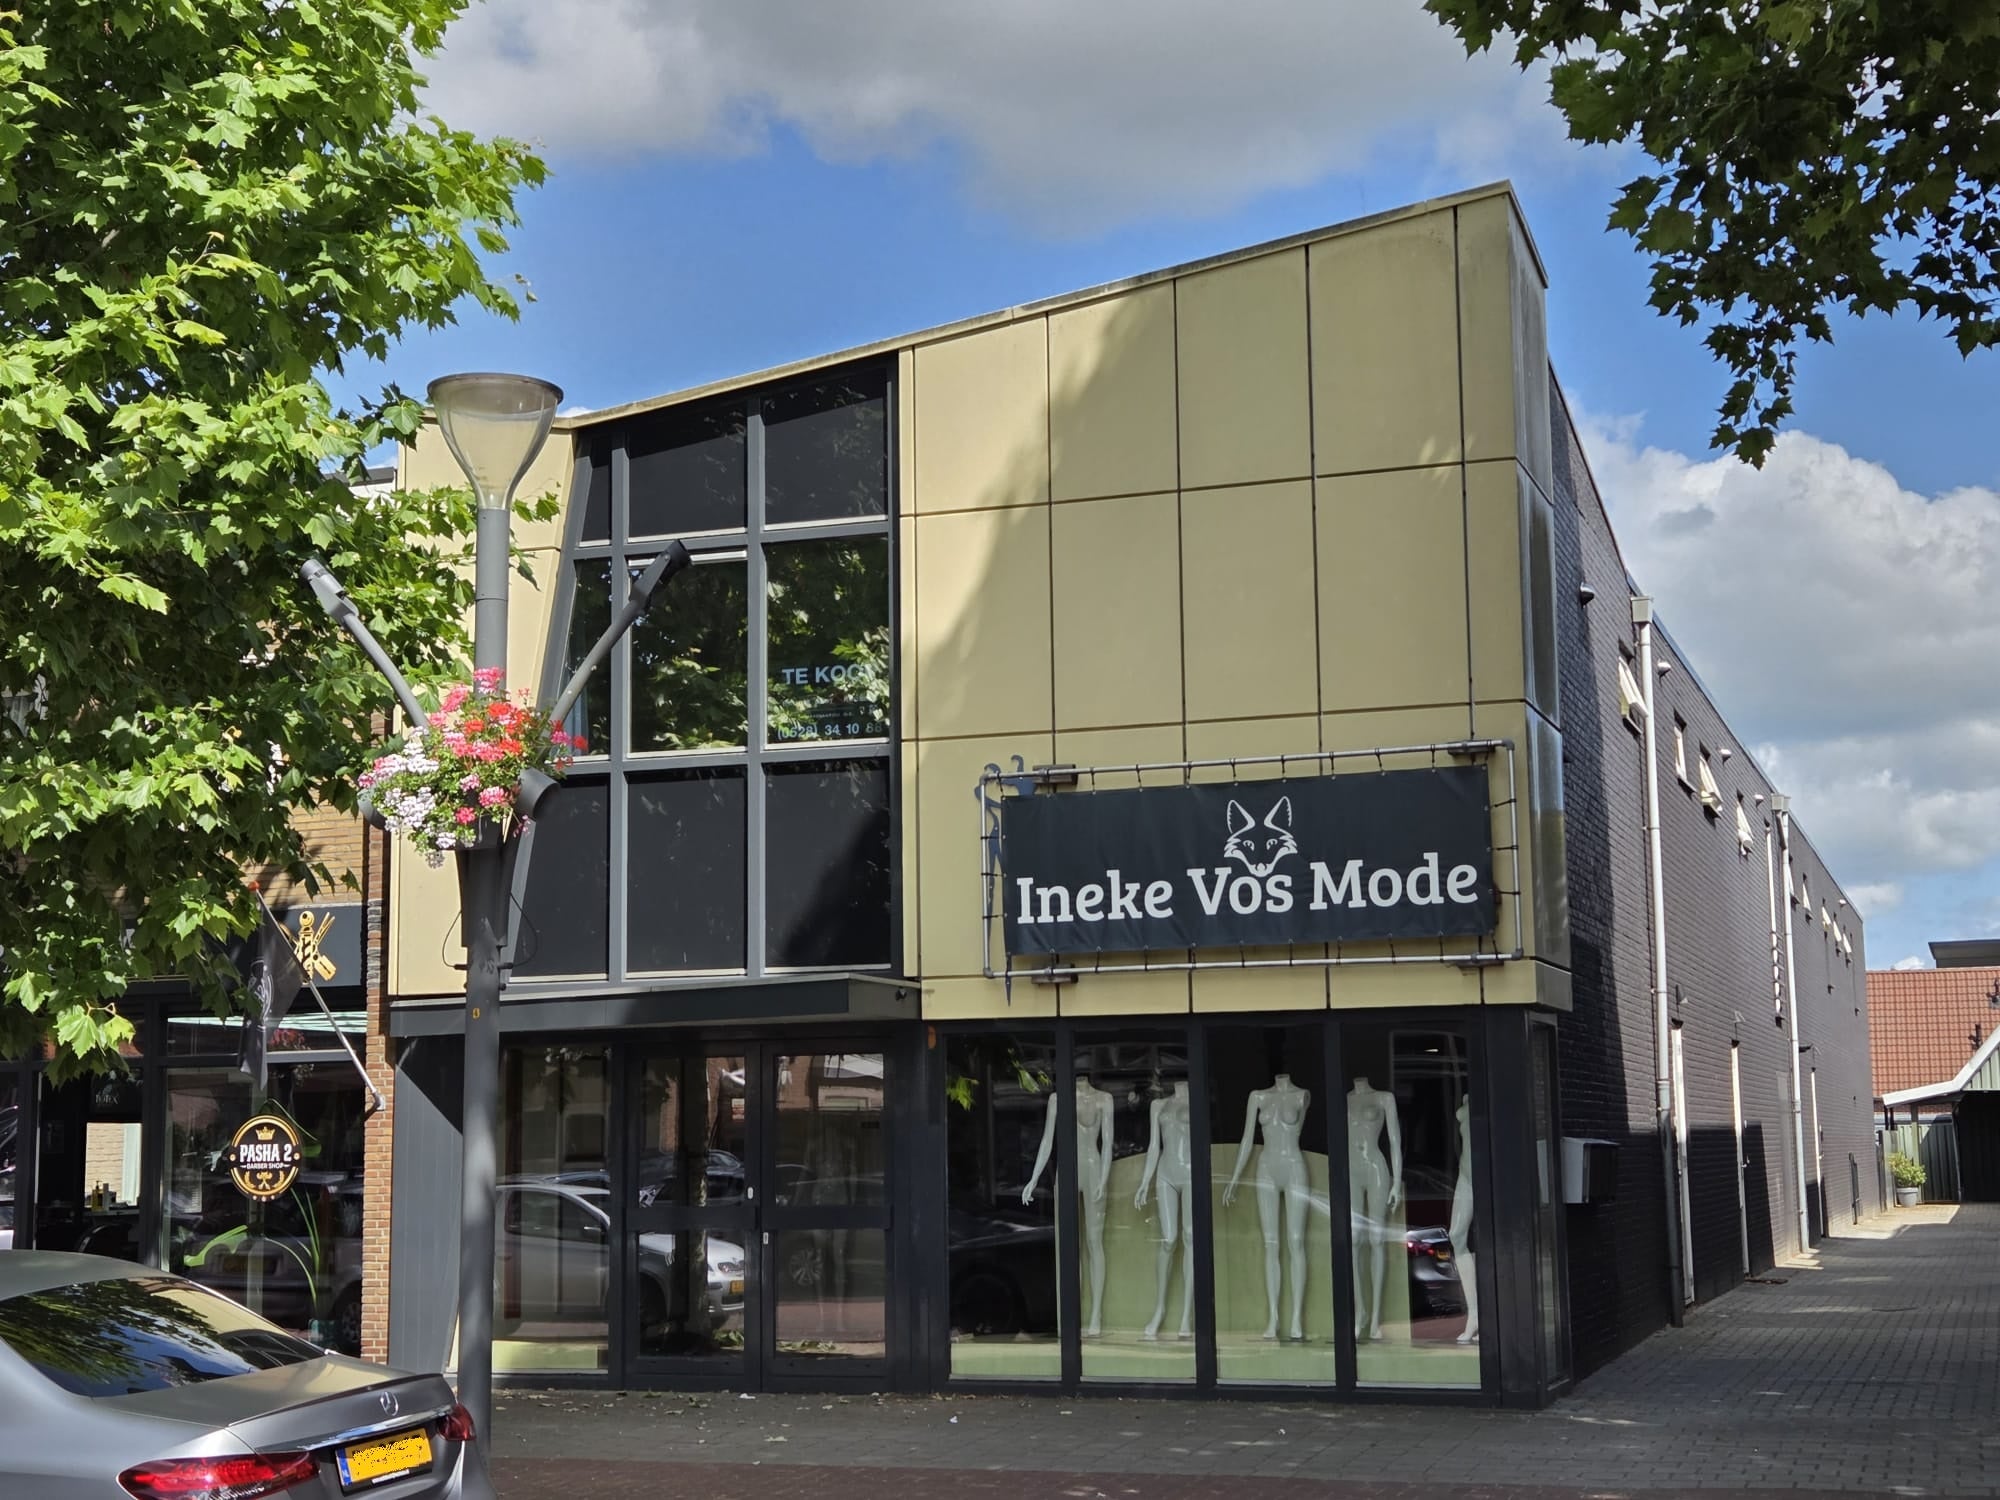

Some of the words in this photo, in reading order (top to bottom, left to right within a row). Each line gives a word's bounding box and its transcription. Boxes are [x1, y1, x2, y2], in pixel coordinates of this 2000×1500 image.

[781, 667, 809, 685] TE
[815, 664, 878, 684] KOO
[824, 724, 841, 736] 34
[846, 722, 860, 735] 10
[1016, 869, 1174, 925] Ineke
[1186, 867, 1294, 916] Vos
[1308, 852, 1479, 912] Mode
[240, 1144, 280, 1162] PASHA
[283, 1143, 292, 1161] 2
[246, 1162, 268, 1170] BARBER
